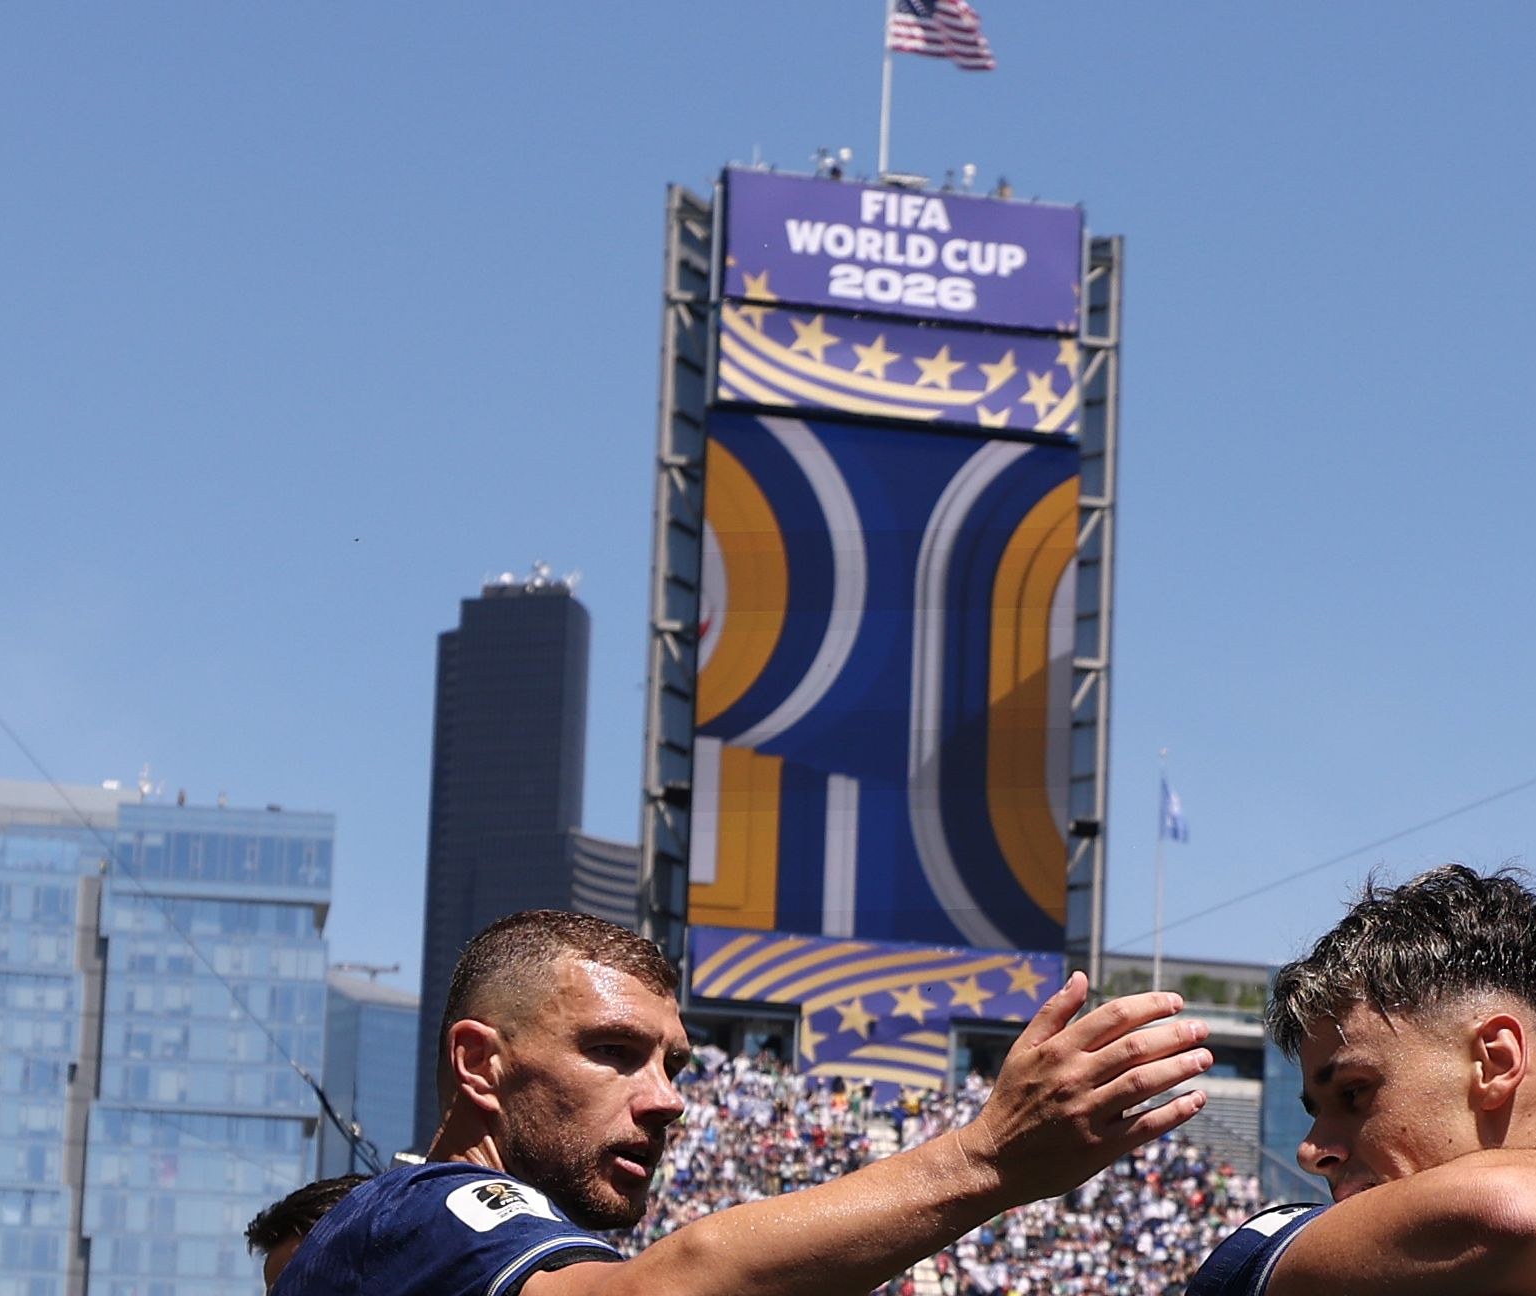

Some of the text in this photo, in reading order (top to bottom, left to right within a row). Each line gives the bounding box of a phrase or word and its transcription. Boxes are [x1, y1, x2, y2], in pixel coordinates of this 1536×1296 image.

[861, 190, 951, 232] FIFA
[785, 219, 1027, 277] WORLD CUP
[828, 263, 977, 312] 2026
